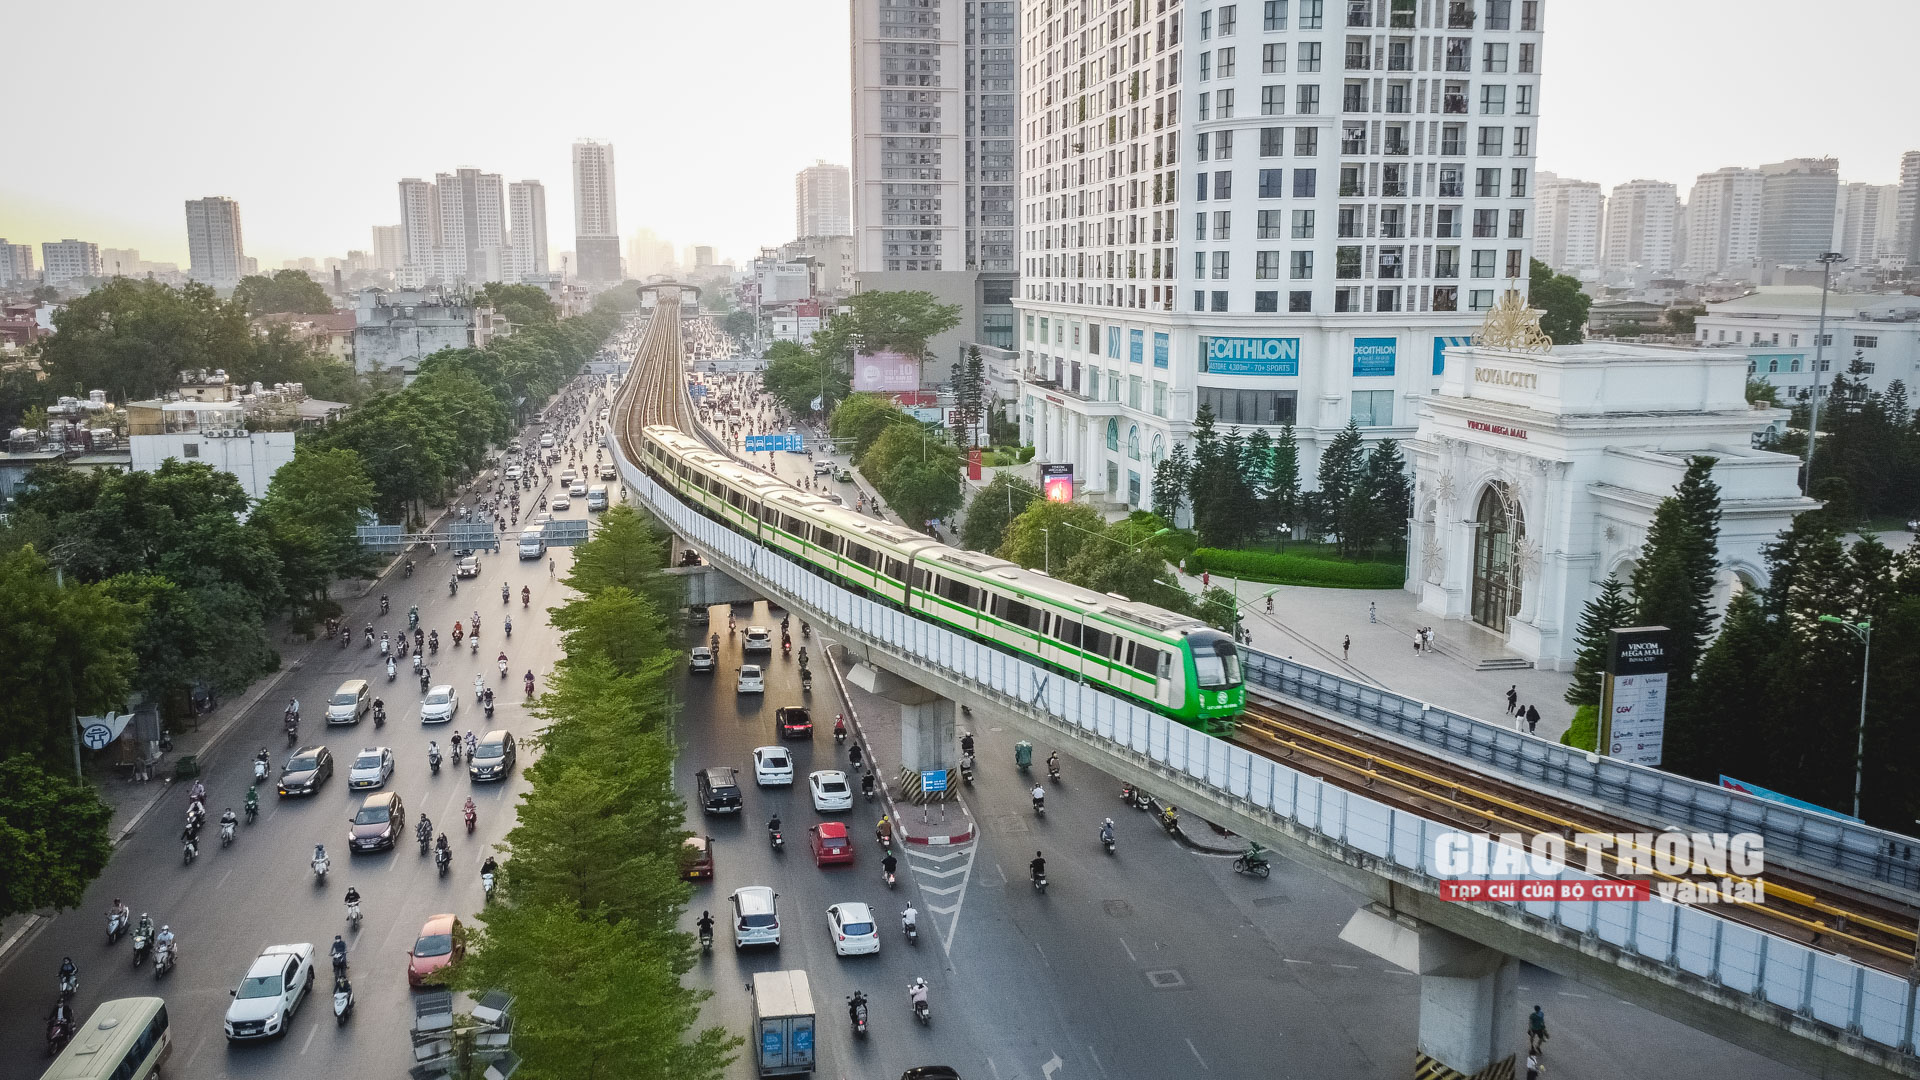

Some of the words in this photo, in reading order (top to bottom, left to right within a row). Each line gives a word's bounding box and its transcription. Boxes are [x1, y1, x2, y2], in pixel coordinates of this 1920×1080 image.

[1354, 346, 1395, 355] DECATHLON
[899, 364, 912, 375] 10
[1254, 364, 1265, 372] 70+
[1266, 364, 1290, 372] SPORTS
[1467, 420, 1491, 433] VINCOM
[1492, 425, 1509, 436] MEGA
[1510, 428, 1528, 440] MALL
[1628, 642, 1658, 650] VINCOM
[1643, 648, 1664, 656] MALL
[1616, 706, 1632, 714] CGV
